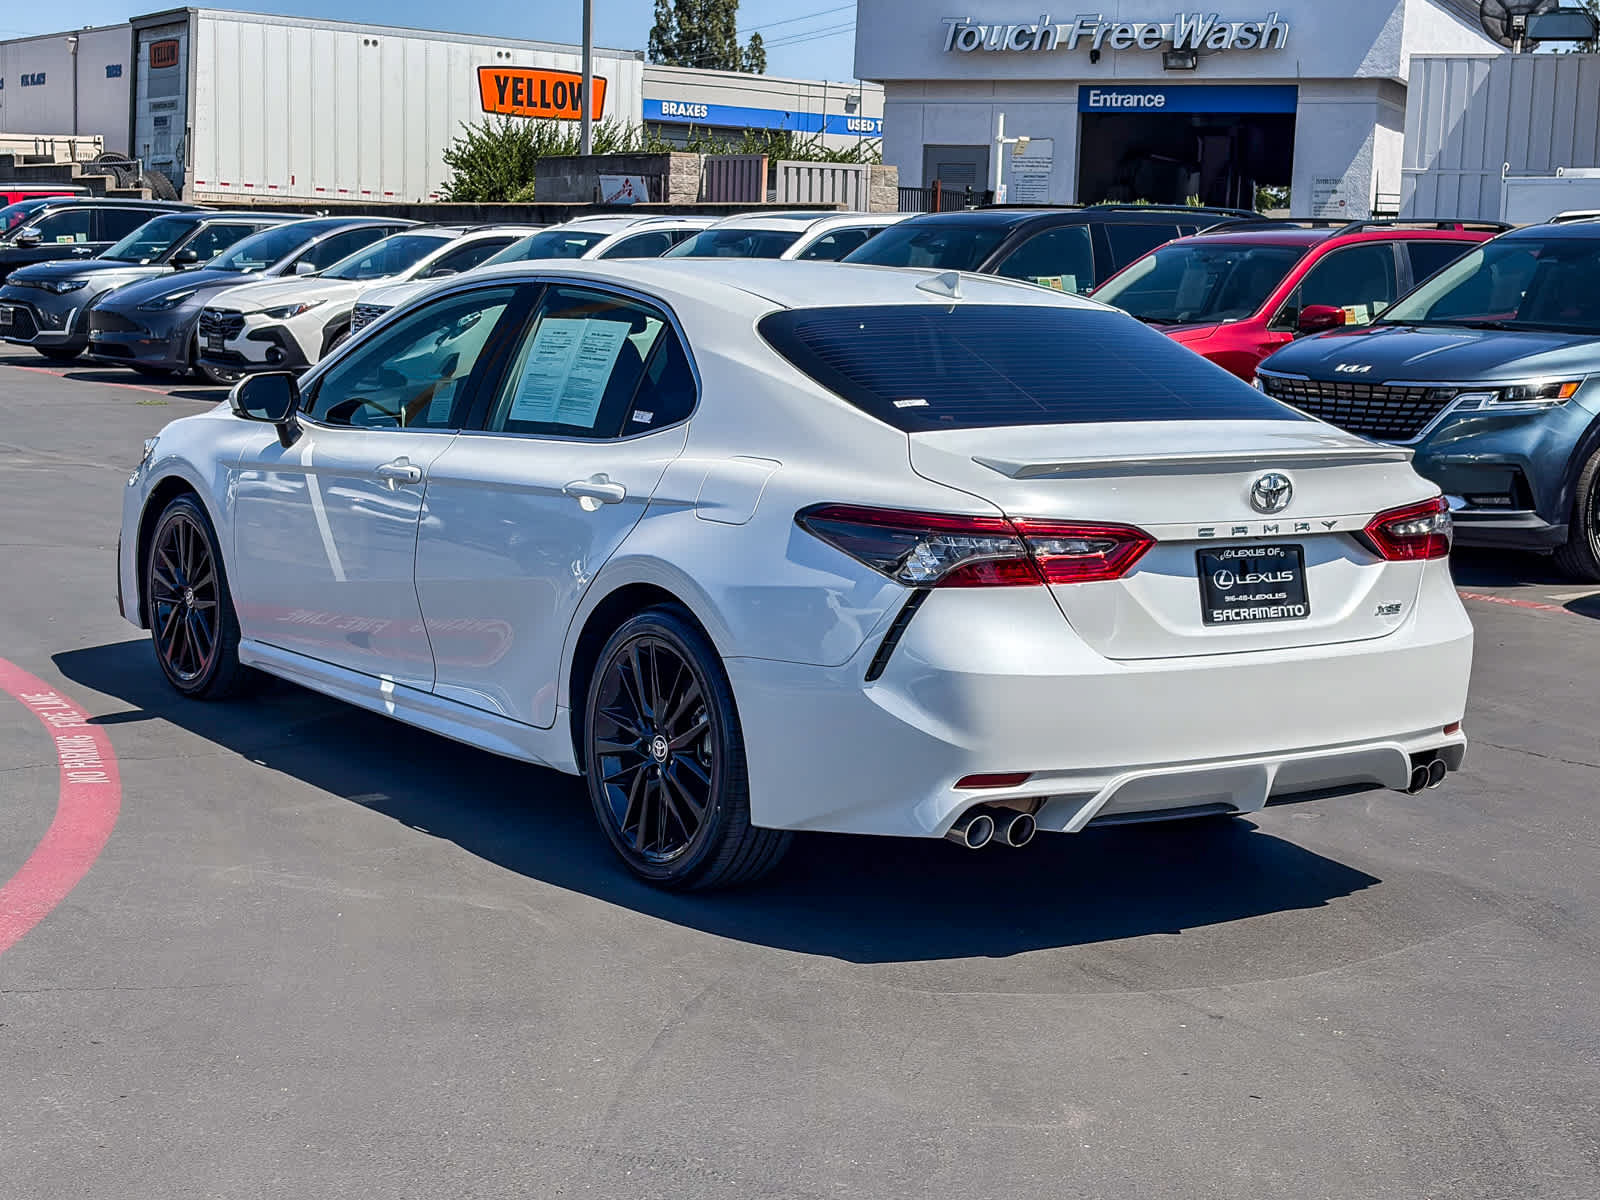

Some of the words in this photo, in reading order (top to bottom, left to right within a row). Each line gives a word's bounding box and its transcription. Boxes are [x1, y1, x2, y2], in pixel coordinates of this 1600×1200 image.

[941, 14, 1058, 52] Touch
[1067, 13, 1164, 51] Free
[1172, 12, 1288, 50] Wash
[1089, 90, 1165, 108] Entrance
[661, 101, 708, 118] BRAKES
[847, 118, 875, 132] USED
[1197, 520, 1338, 537] CAMRY
[1231, 548, 1266, 558] LEXUS
[1267, 547, 1280, 556] OF
[1235, 570, 1294, 585] LEXUS
[1213, 604, 1305, 622] SACRAMENTO
